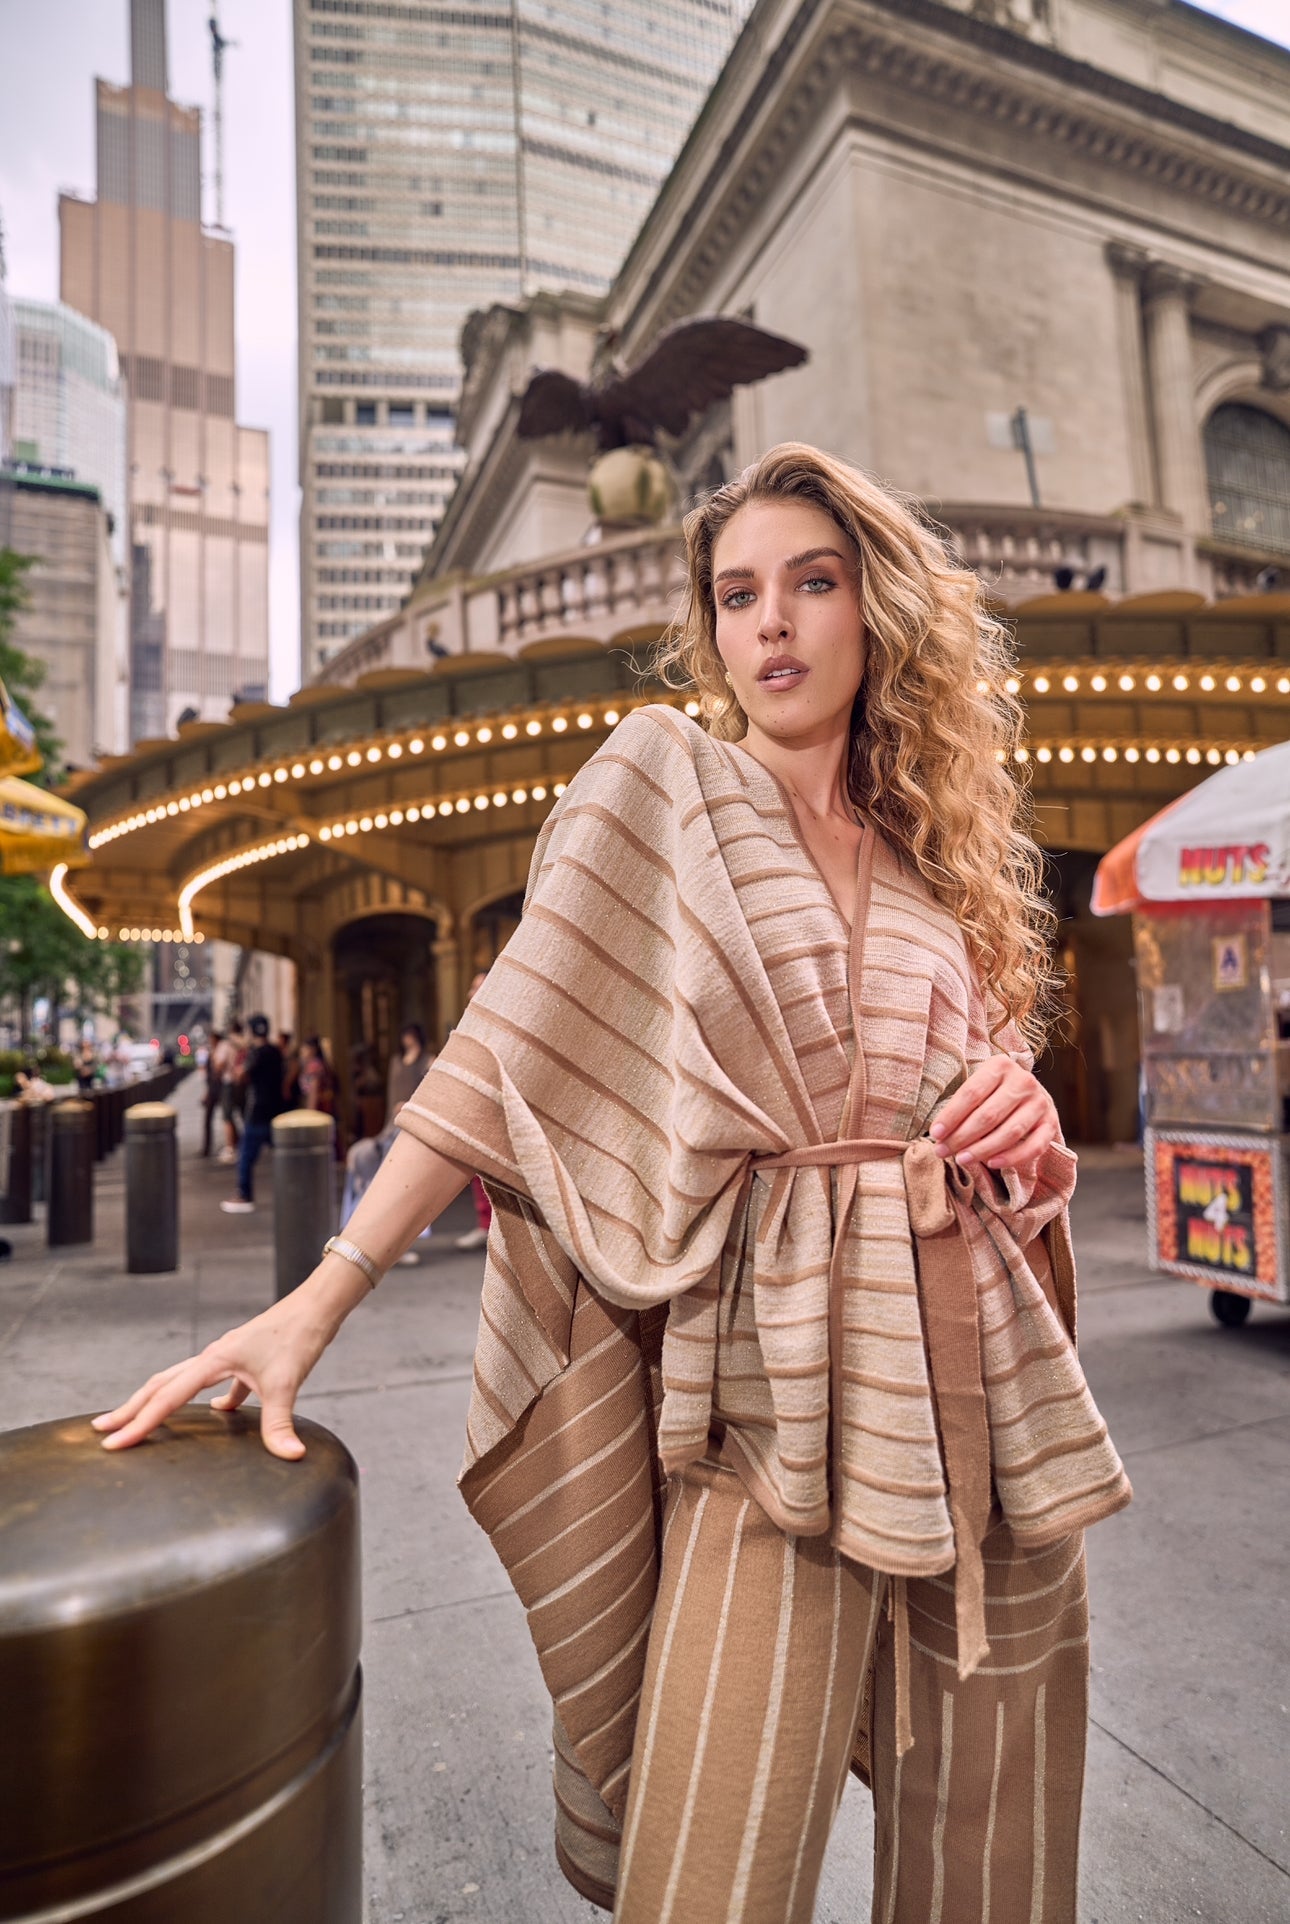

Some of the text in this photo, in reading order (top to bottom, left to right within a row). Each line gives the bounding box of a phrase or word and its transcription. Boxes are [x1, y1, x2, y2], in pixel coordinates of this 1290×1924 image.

[1179, 843, 1270, 887] NUTS
[1220, 946, 1238, 974] A
[1179, 1164, 1242, 1212] NUTS
[1202, 1192, 1230, 1233] 4
[1187, 1217, 1250, 1269] NUTS
